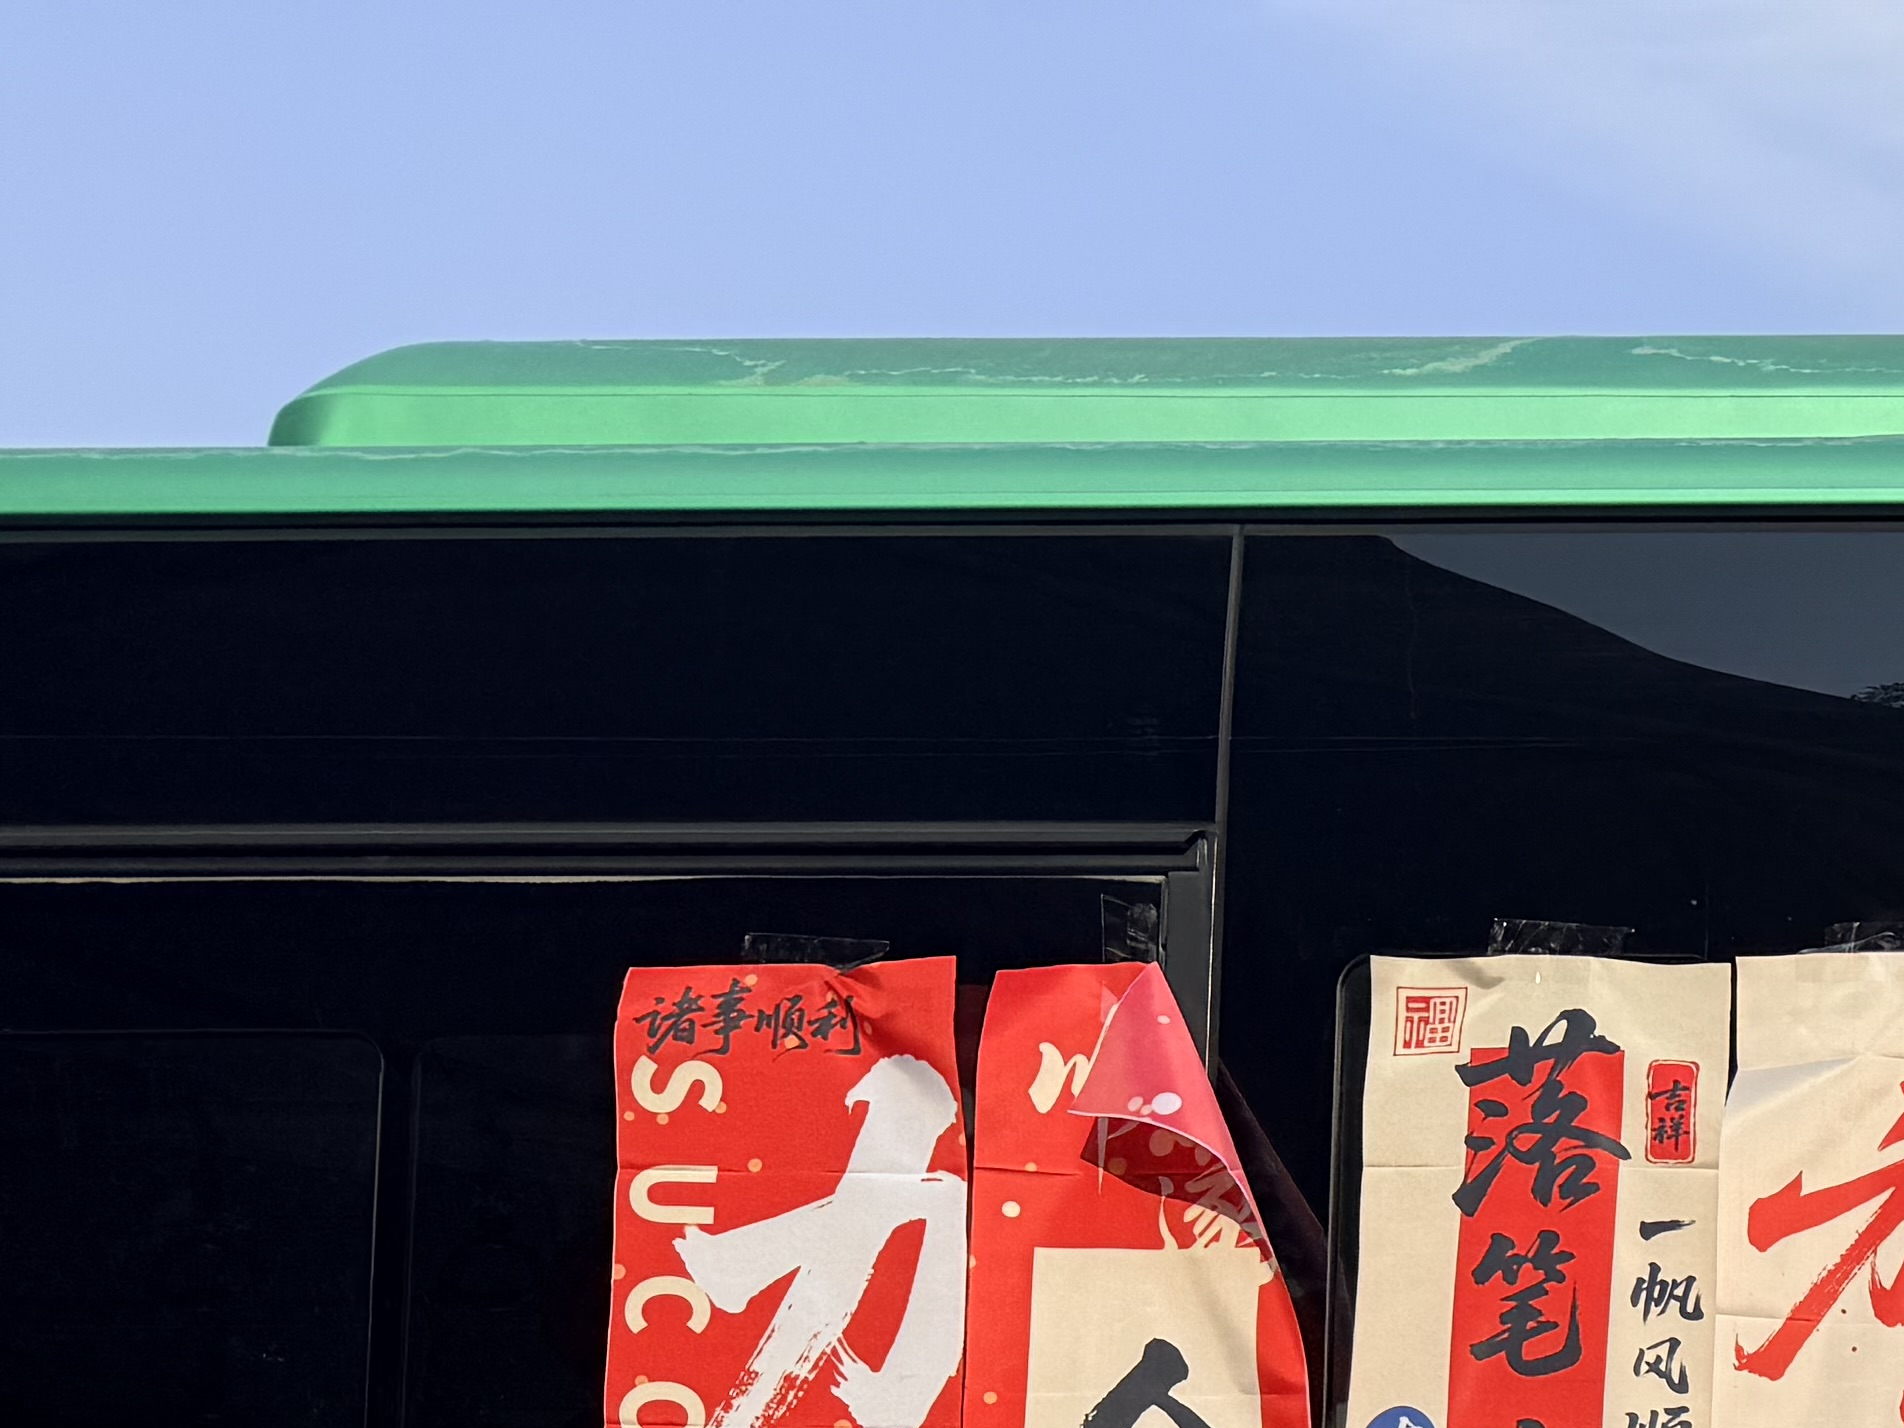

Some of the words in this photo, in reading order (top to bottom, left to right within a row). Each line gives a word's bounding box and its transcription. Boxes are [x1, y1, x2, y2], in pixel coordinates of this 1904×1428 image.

[632, 978, 863, 1057] 诸事顺利
[1647, 1078, 1692, 1149] 吉祥
